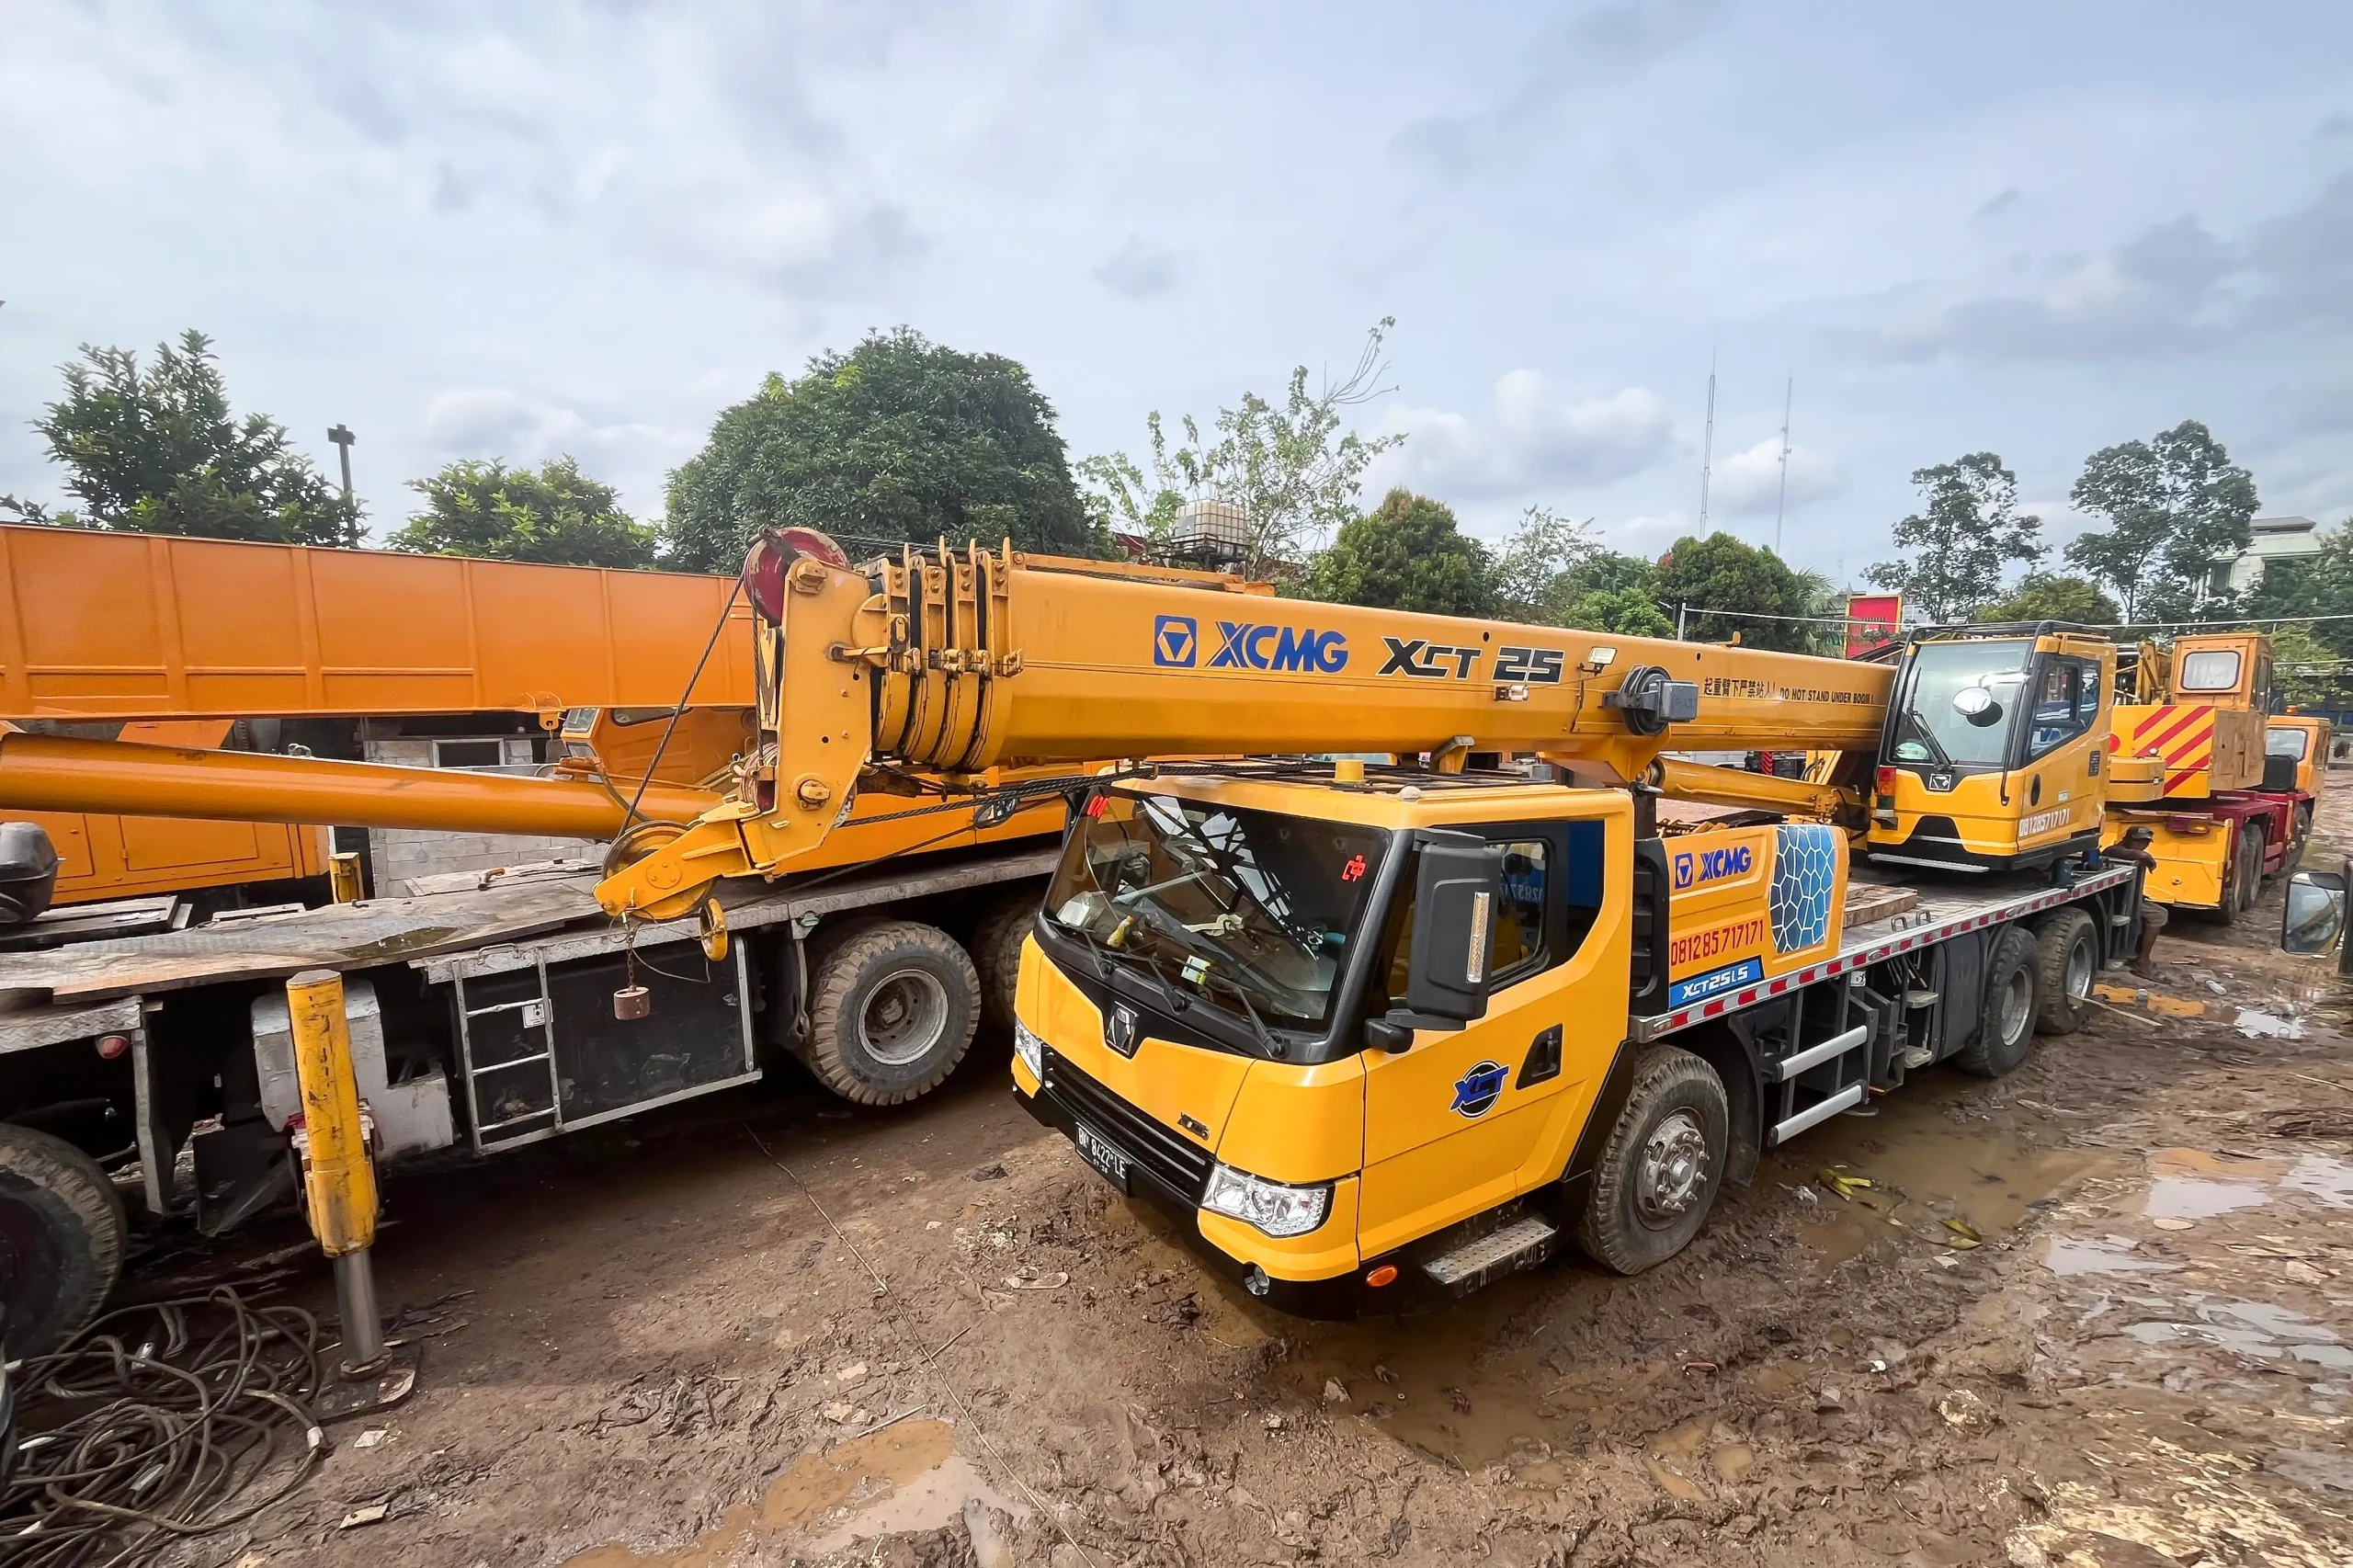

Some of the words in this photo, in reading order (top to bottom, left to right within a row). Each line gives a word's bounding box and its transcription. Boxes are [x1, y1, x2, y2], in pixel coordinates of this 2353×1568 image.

[1205, 620, 1349, 673] XCMG
[1376, 635, 1483, 680] XCT
[1492, 645, 1566, 685] 25
[1779, 687, 1790, 700] DO
[1791, 687, 1806, 701] NOT
[1807, 689, 1830, 702] STAND
[1831, 691, 1852, 704] UNDER
[1698, 846, 1752, 882] XCMG
[1449, 1063, 1511, 1112] XCT
[1091, 1138, 1111, 1168] 8422
[1114, 1155, 1127, 1179] LE
